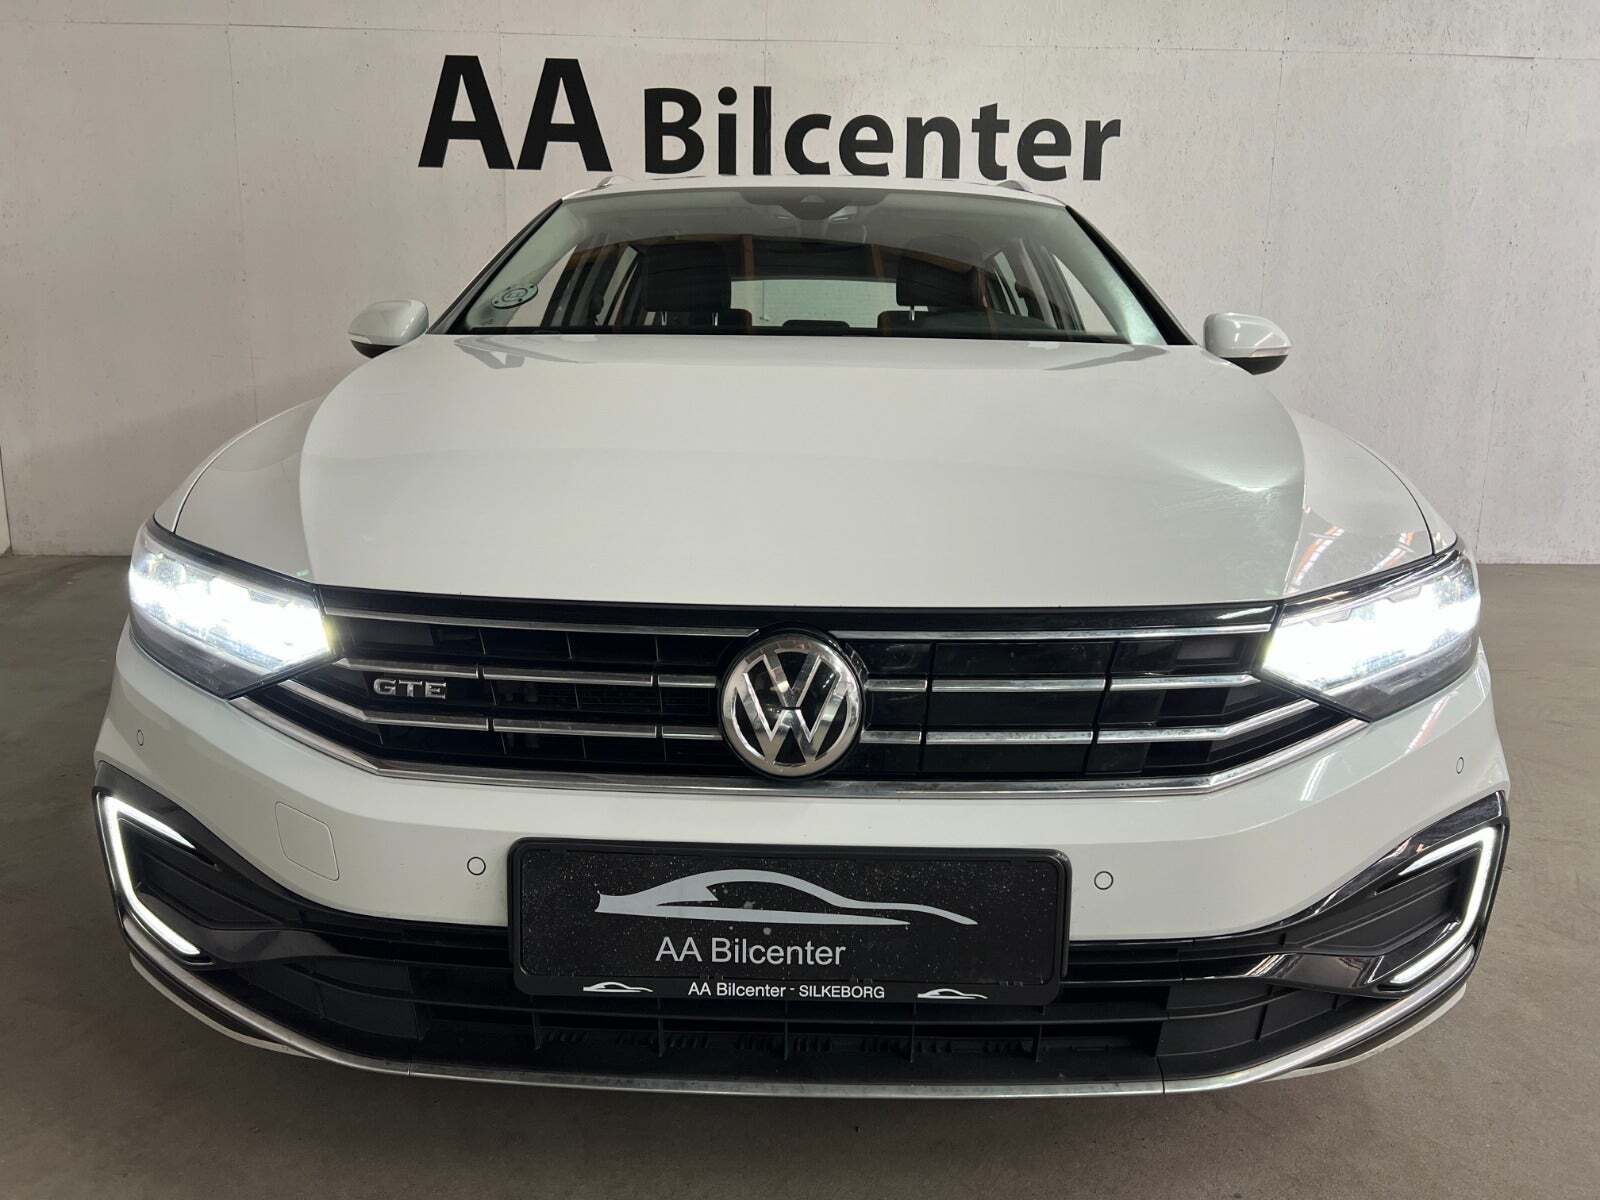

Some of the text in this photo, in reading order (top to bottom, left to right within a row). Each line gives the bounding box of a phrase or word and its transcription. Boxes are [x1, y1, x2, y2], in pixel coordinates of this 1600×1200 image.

[418, 54, 1121, 182] AA Bilcenter
[373, 678, 447, 699] GTE
[729, 643, 856, 770] VW
[656, 937, 847, 965] AA Bilcenter
[688, 982, 711, 997] AA
[716, 982, 786, 998] Bilcenter
[798, 985, 885, 999] SILKEBORG
